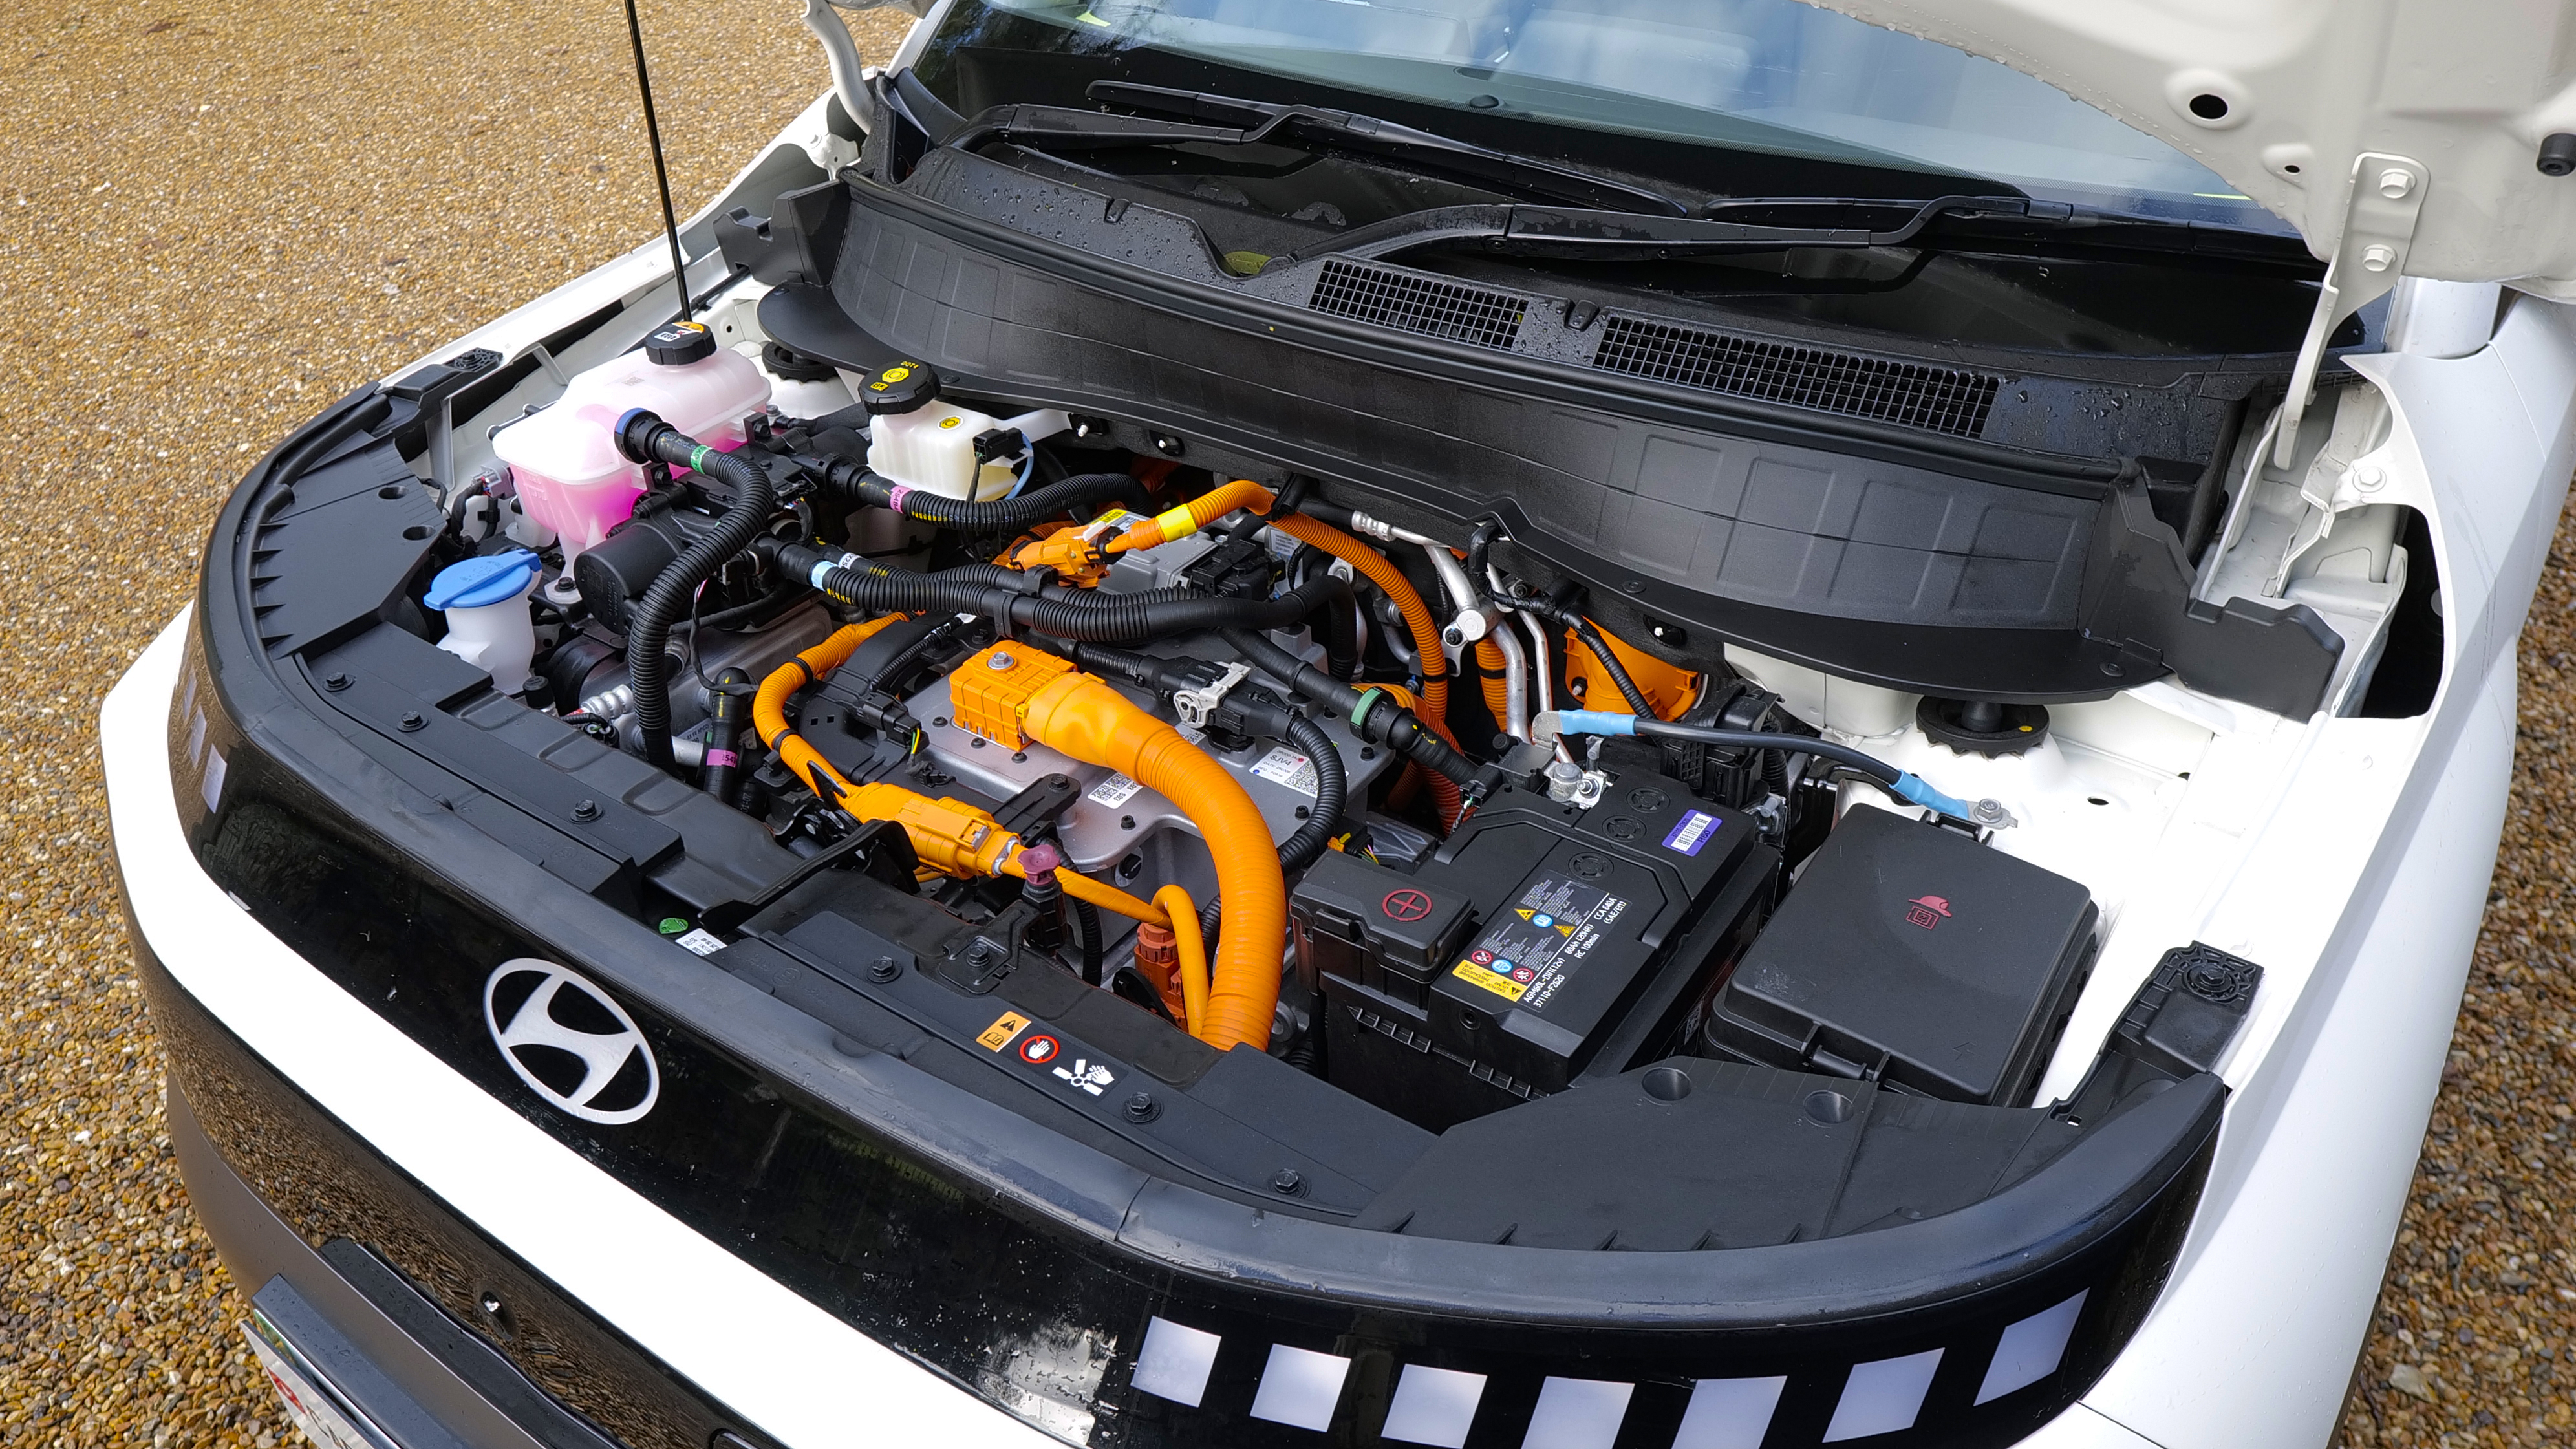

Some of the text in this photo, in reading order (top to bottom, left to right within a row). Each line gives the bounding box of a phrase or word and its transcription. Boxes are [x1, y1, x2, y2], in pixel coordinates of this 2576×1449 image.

[901, 361, 919, 369] DOT4
[1270, 755, 1292, 766] 8JV4
[1697, 830, 1711, 843] R60
[1564, 941, 1578, 955] 60Ah
[1576, 923, 1594, 943] (20HR)
[1593, 909, 1605, 921] CCA
[1602, 897, 1617, 912] 640A
[1533, 901, 1627, 1008] 37110-F2620 RC 100min (SAE/EN)
